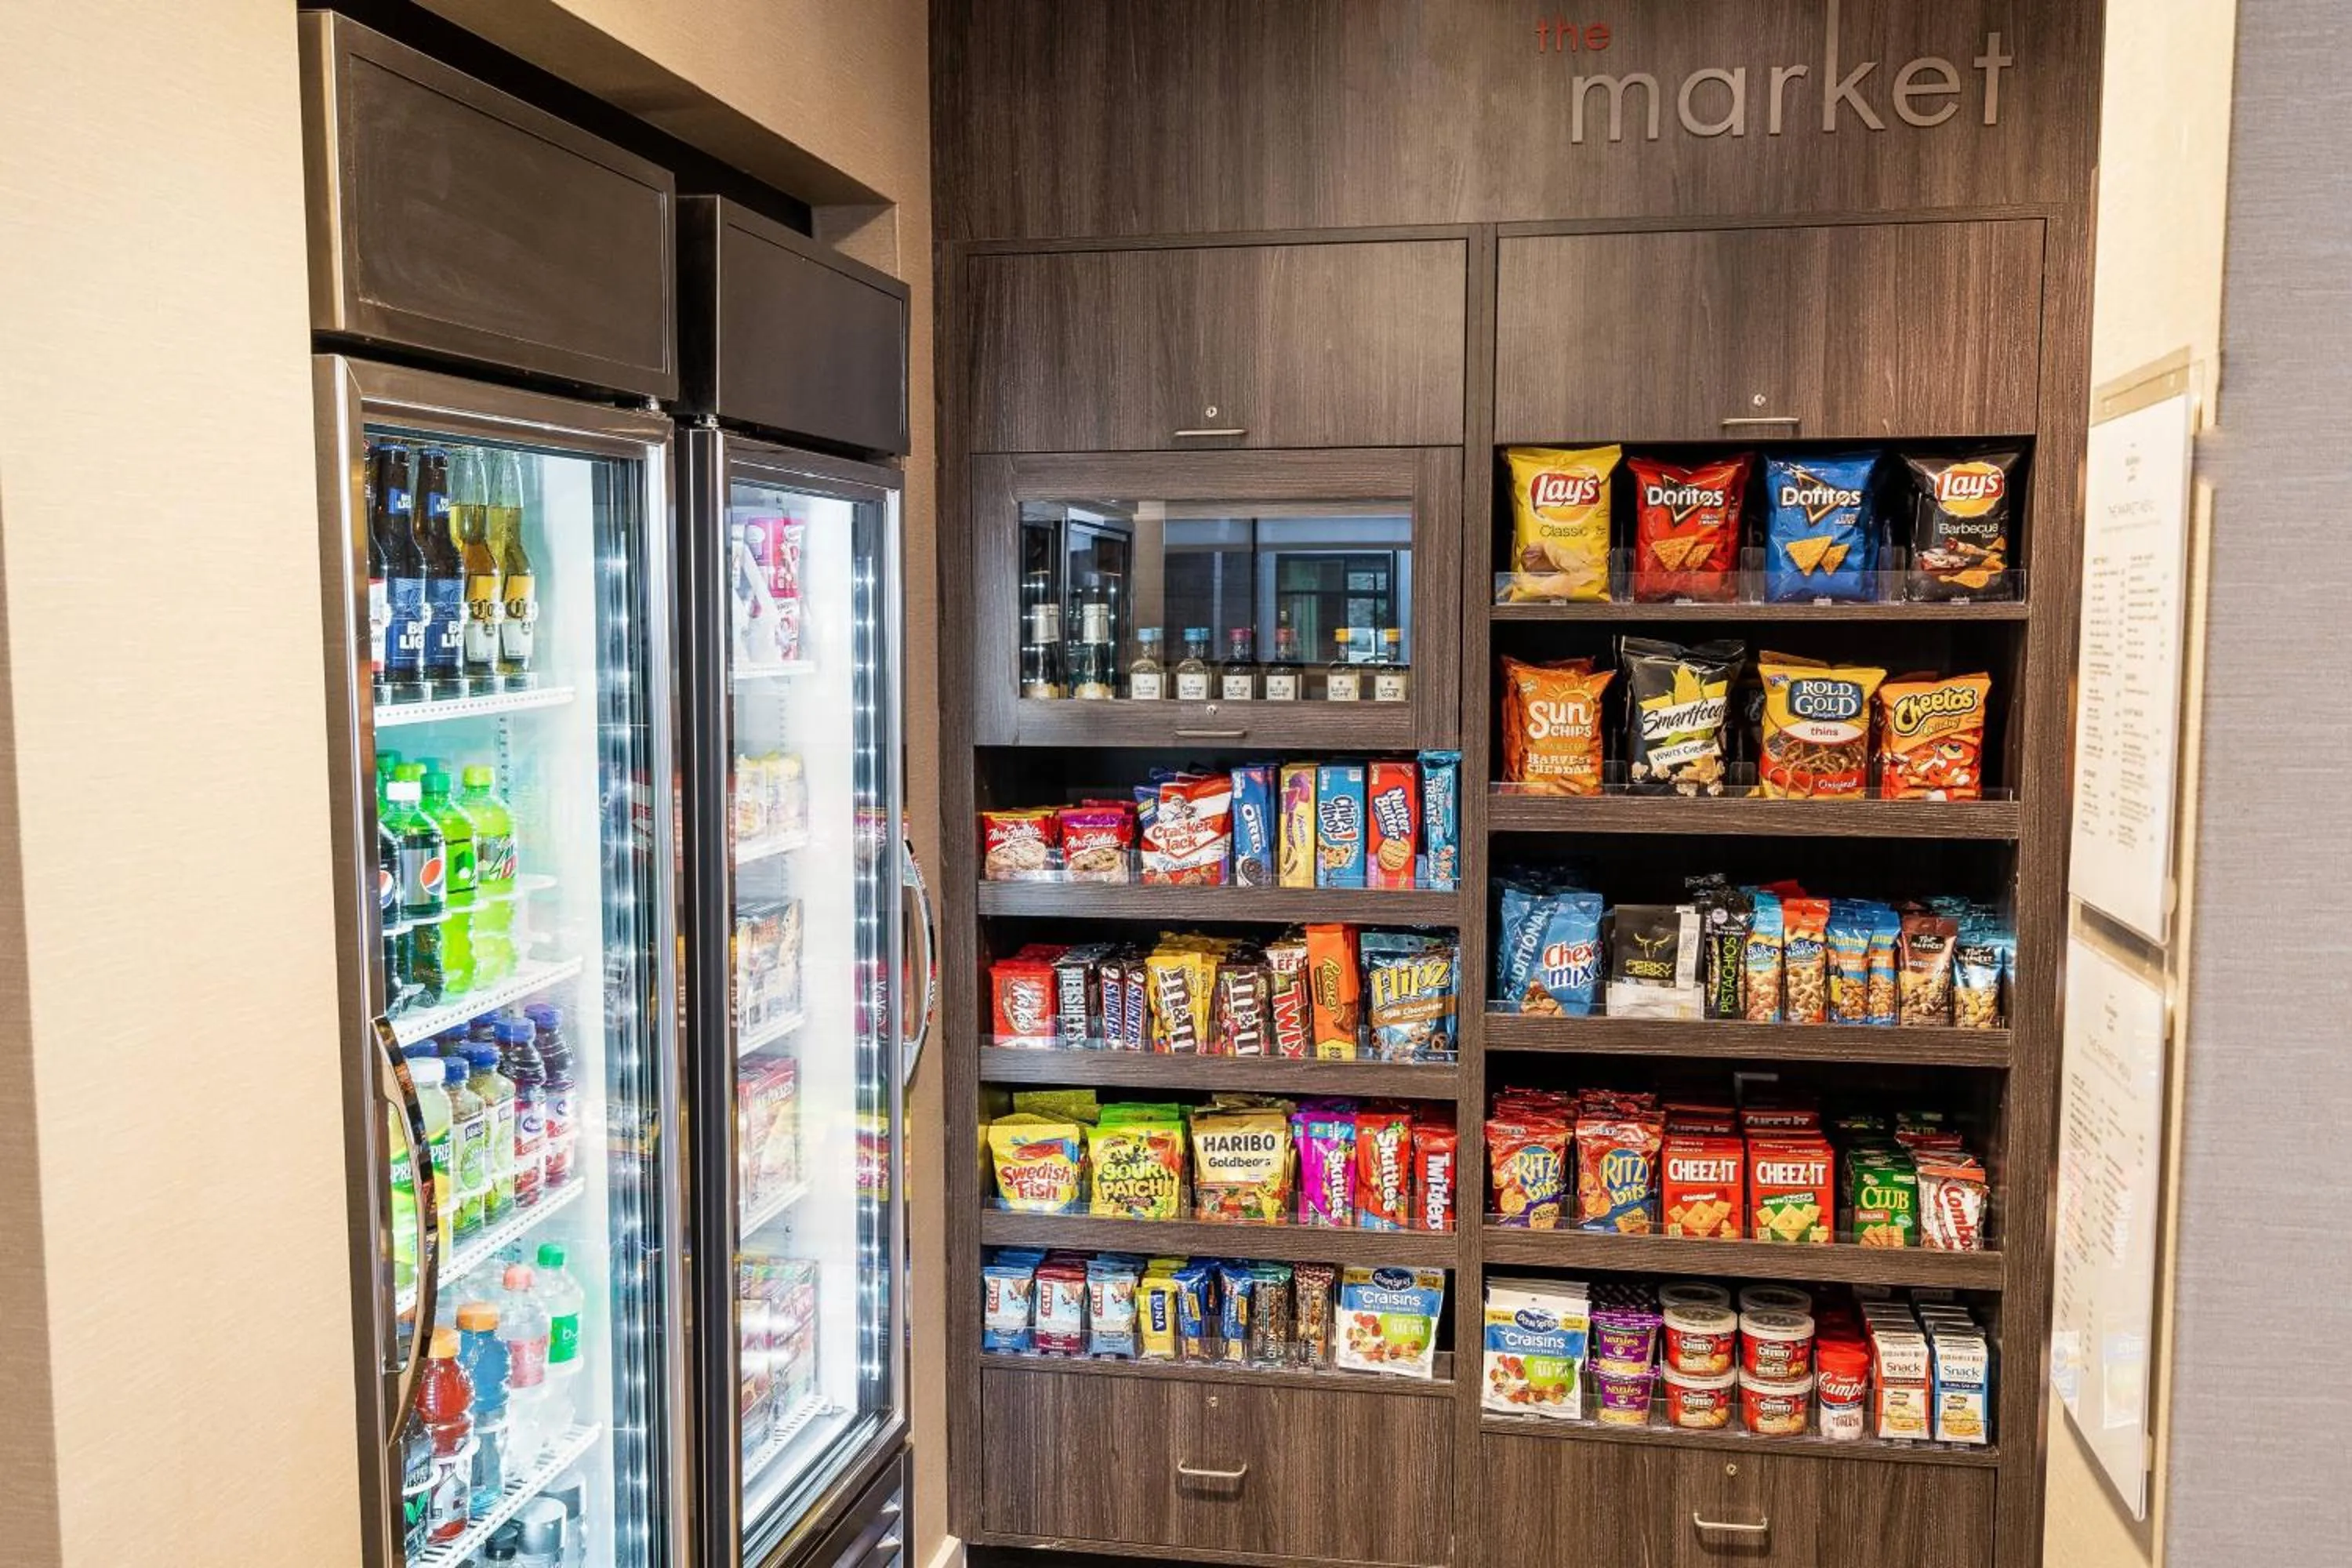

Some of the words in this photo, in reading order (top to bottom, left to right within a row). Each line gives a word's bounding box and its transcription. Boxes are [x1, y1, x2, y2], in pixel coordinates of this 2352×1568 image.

[1534, 16, 1610, 53] the
[1570, 0, 2013, 143] market
[1535, 473, 1599, 506] Lay's
[1647, 485, 1724, 506] Doritos
[1780, 486, 1862, 507] Doritos
[1940, 472, 2000, 501] Lay's
[1539, 524, 1588, 537] Classic
[1939, 523, 1999, 536] Barbecue
[1802, 681, 1853, 697] ROLD
[1794, 695, 1858, 716] GOLD
[1894, 688, 1976, 734] Cheetos
[1529, 700, 1593, 739] Sun
[1549, 725, 1593, 738] CHIPS
[1809, 726, 1839, 737] thins
[1375, 796, 1401, 841] Butter
[1388, 788, 1411, 834] Nutter
[1152, 820, 1212, 840] Cracker
[1240, 803, 1261, 854] OREO
[1165, 835, 1198, 853] Jack
[1542, 942, 1595, 969] Chex
[1721, 936, 1737, 1012] PISTACHIOS
[1203, 1134, 1276, 1152] HARIBO
[1000, 1162, 1072, 1187] Swedish
[1376, 1129, 1400, 1213] Skittles
[1602, 1153, 1648, 1189] RITZ
[1014, 1178, 1058, 1200] Fish
[1101, 1178, 1165, 1201] PATCH
[1327, 1149, 1346, 1218] Skittles
[1861, 1186, 1910, 1210] CLUB
[1362, 1289, 1422, 1306] Craisins
[1152, 1292, 1166, 1328] LUNA
[1504, 1332, 1566, 1348] Craisins
[1886, 1362, 1922, 1374] Snack
[1944, 1364, 1980, 1377] Snack
